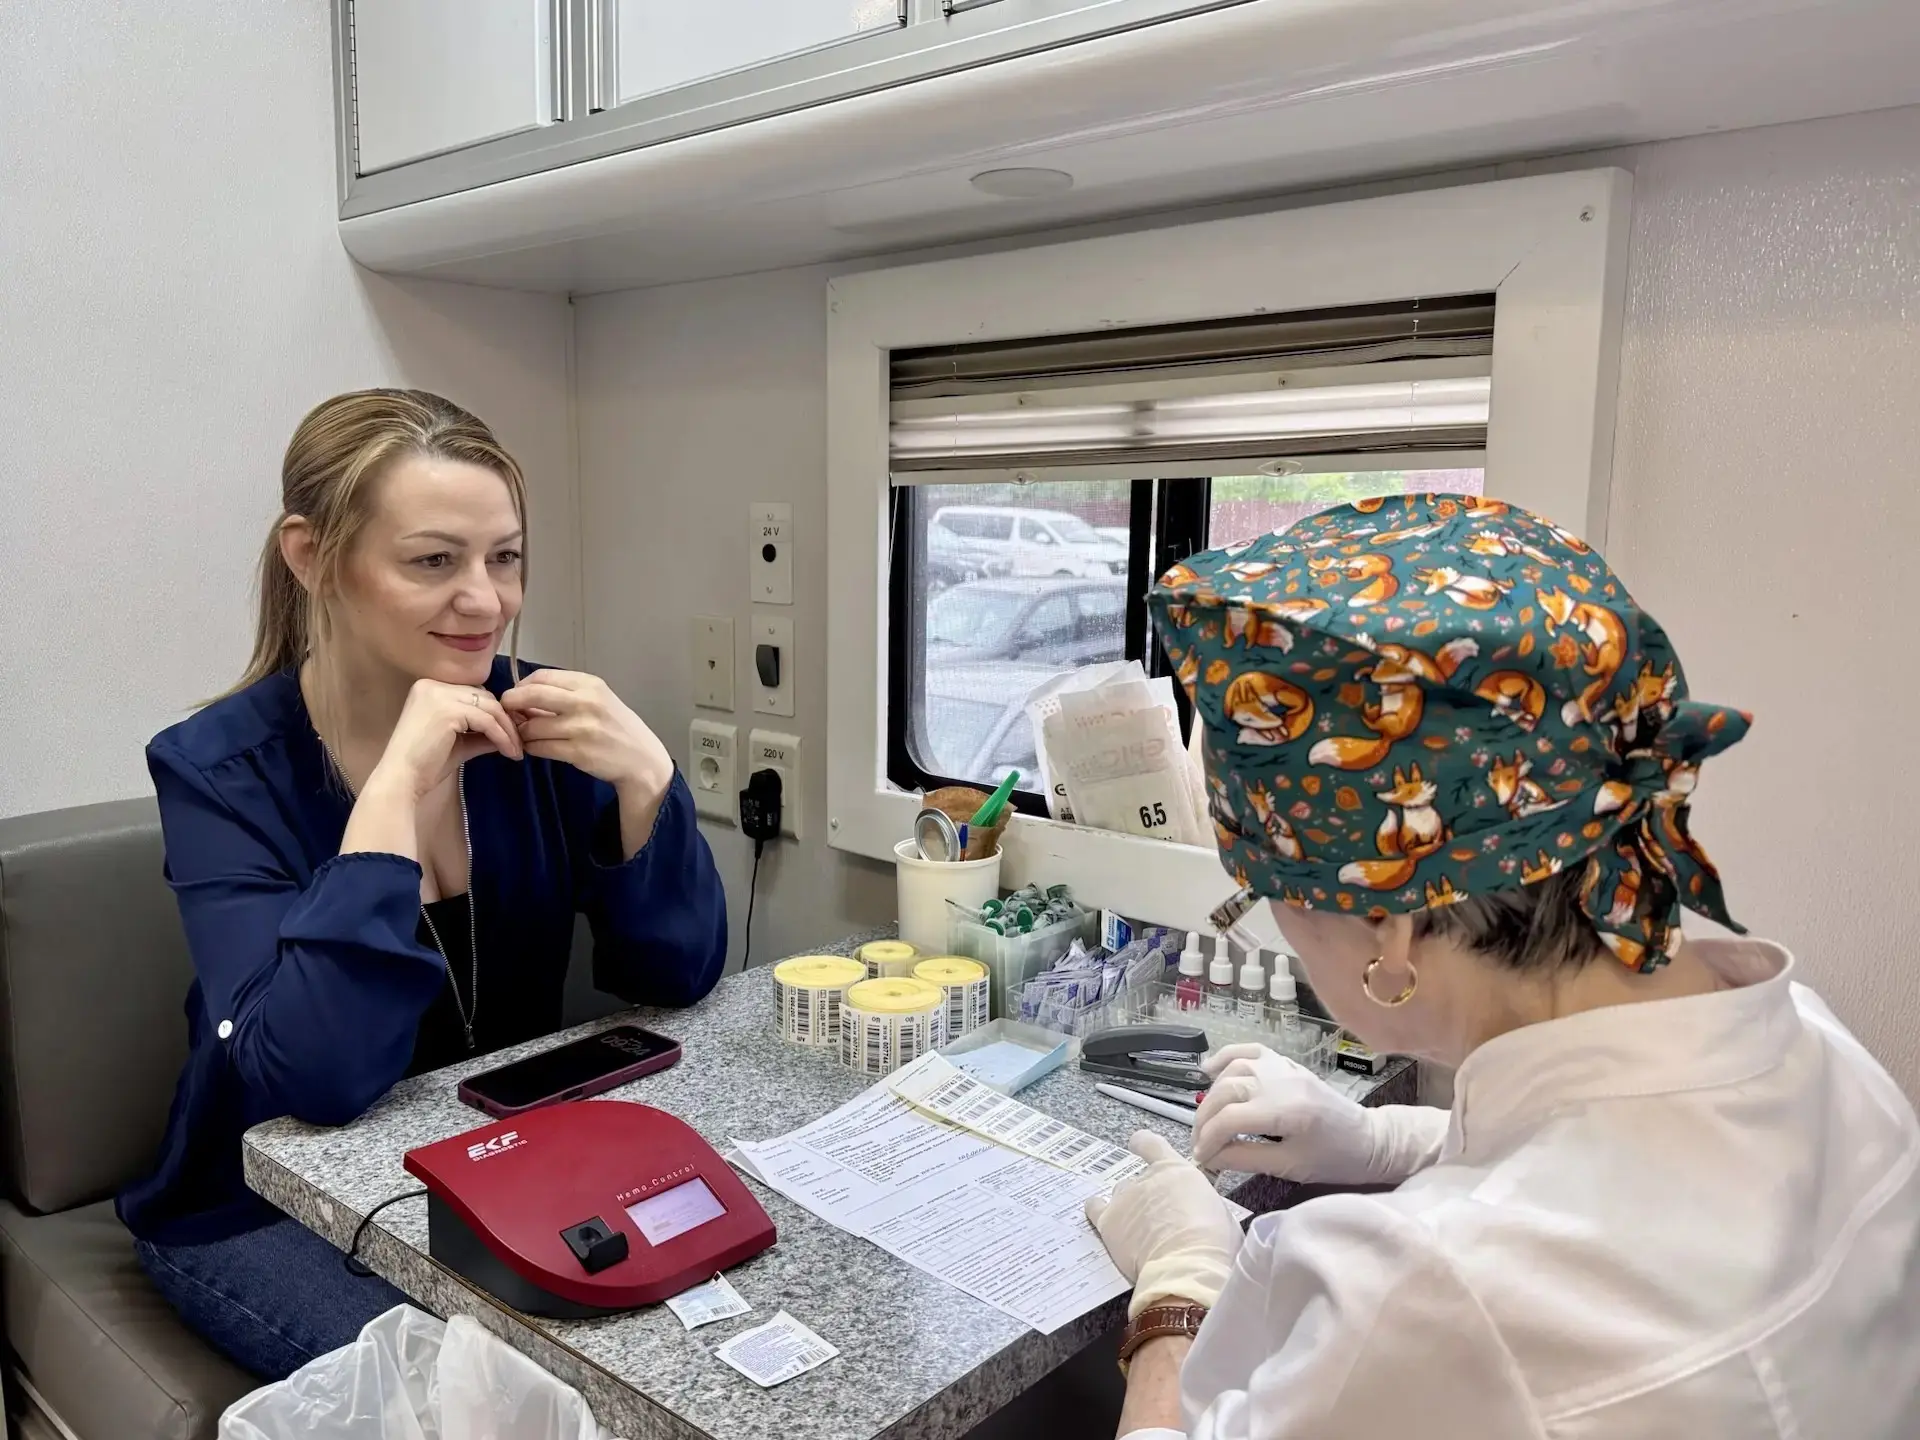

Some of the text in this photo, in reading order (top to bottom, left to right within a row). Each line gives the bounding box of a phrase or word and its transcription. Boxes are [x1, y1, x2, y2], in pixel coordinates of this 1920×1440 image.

[763, 526, 780, 536] 24 V
[702, 737, 721, 750] 220 V
[764, 748, 784, 760] 220 V
[1139, 802, 1167, 828] 6.5
[466, 1130, 518, 1158] EKF
[472, 1140, 528, 1162] DIAGNOSTIC
